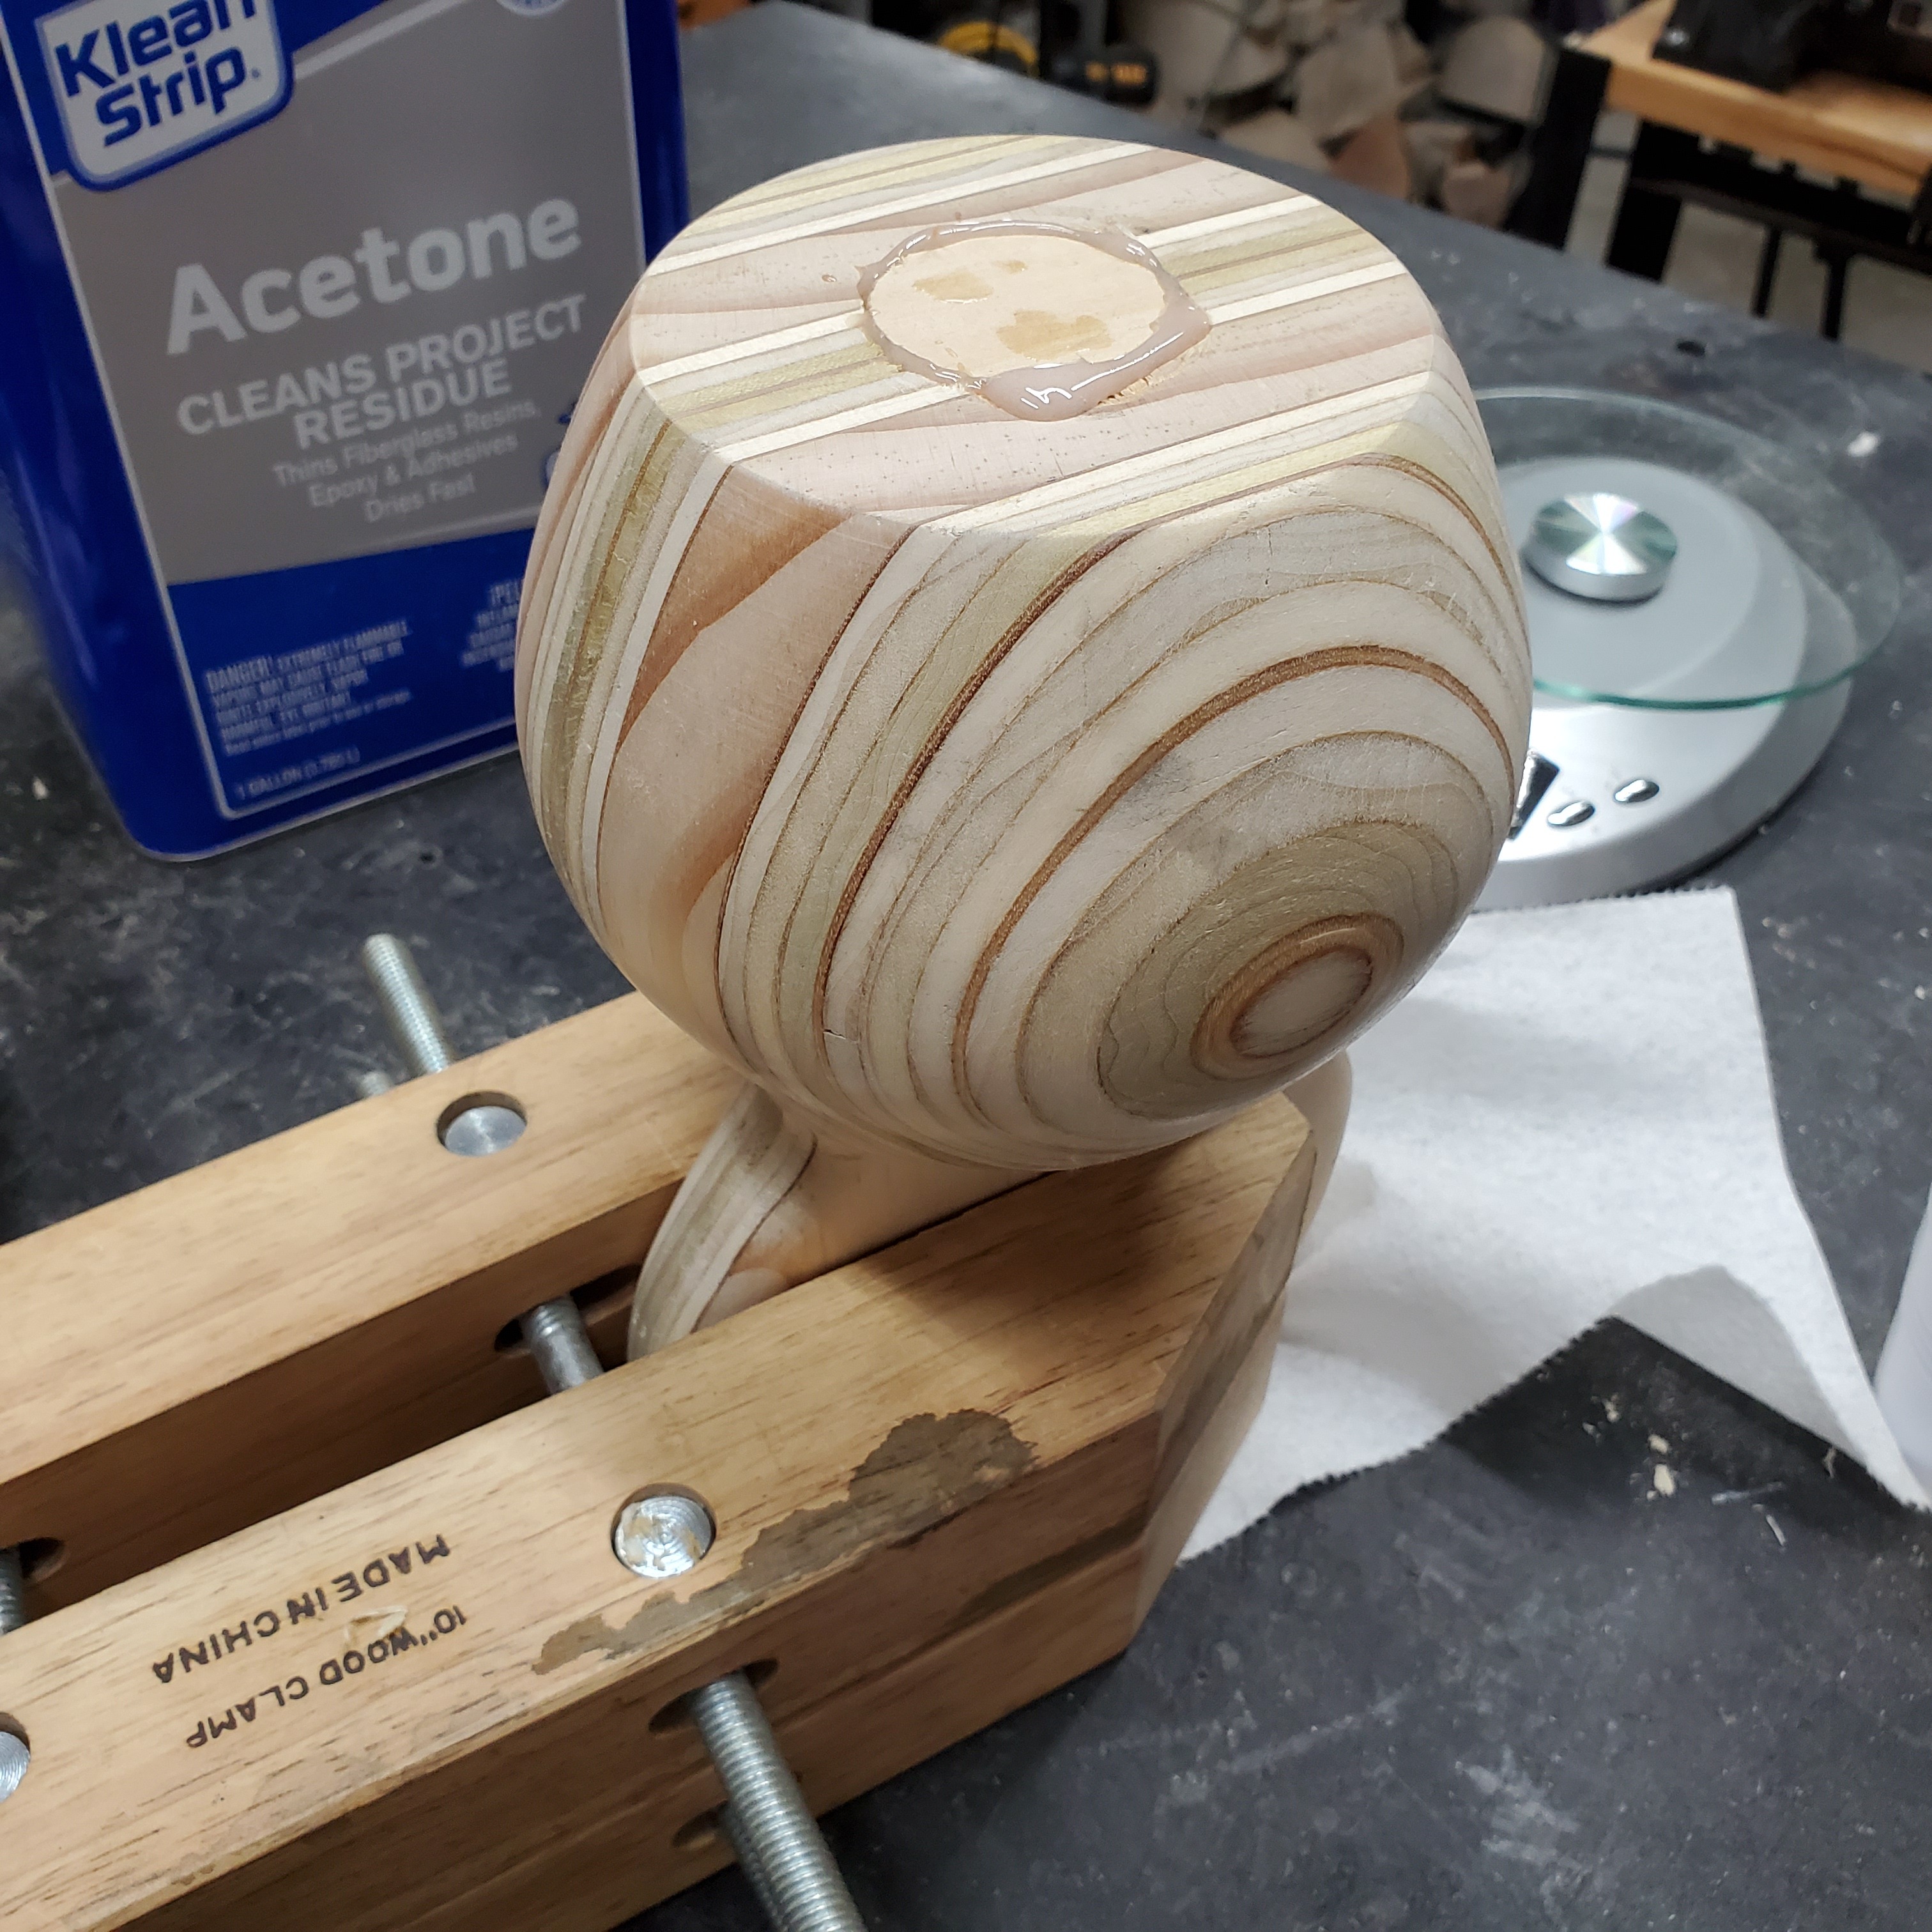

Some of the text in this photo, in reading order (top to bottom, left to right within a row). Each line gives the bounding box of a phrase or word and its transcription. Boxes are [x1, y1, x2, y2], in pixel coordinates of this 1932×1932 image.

[96, 47, 247, 147] Strip
[167, 198, 582, 355] Acetone
[177, 293, 586, 434] CLEANS PROJECT
[293, 358, 512, 448] RESIDUE
[308, 433, 519, 508] Epoxy & Adhesives
[342, 422, 459, 468] Fiberglass
[364, 471, 477, 522] Dries Fast
[152, 1534, 451, 1683] MADE IN CHINA
[319, 1627, 418, 1686] WOOD
[186, 1676, 310, 1748] CLAMP
